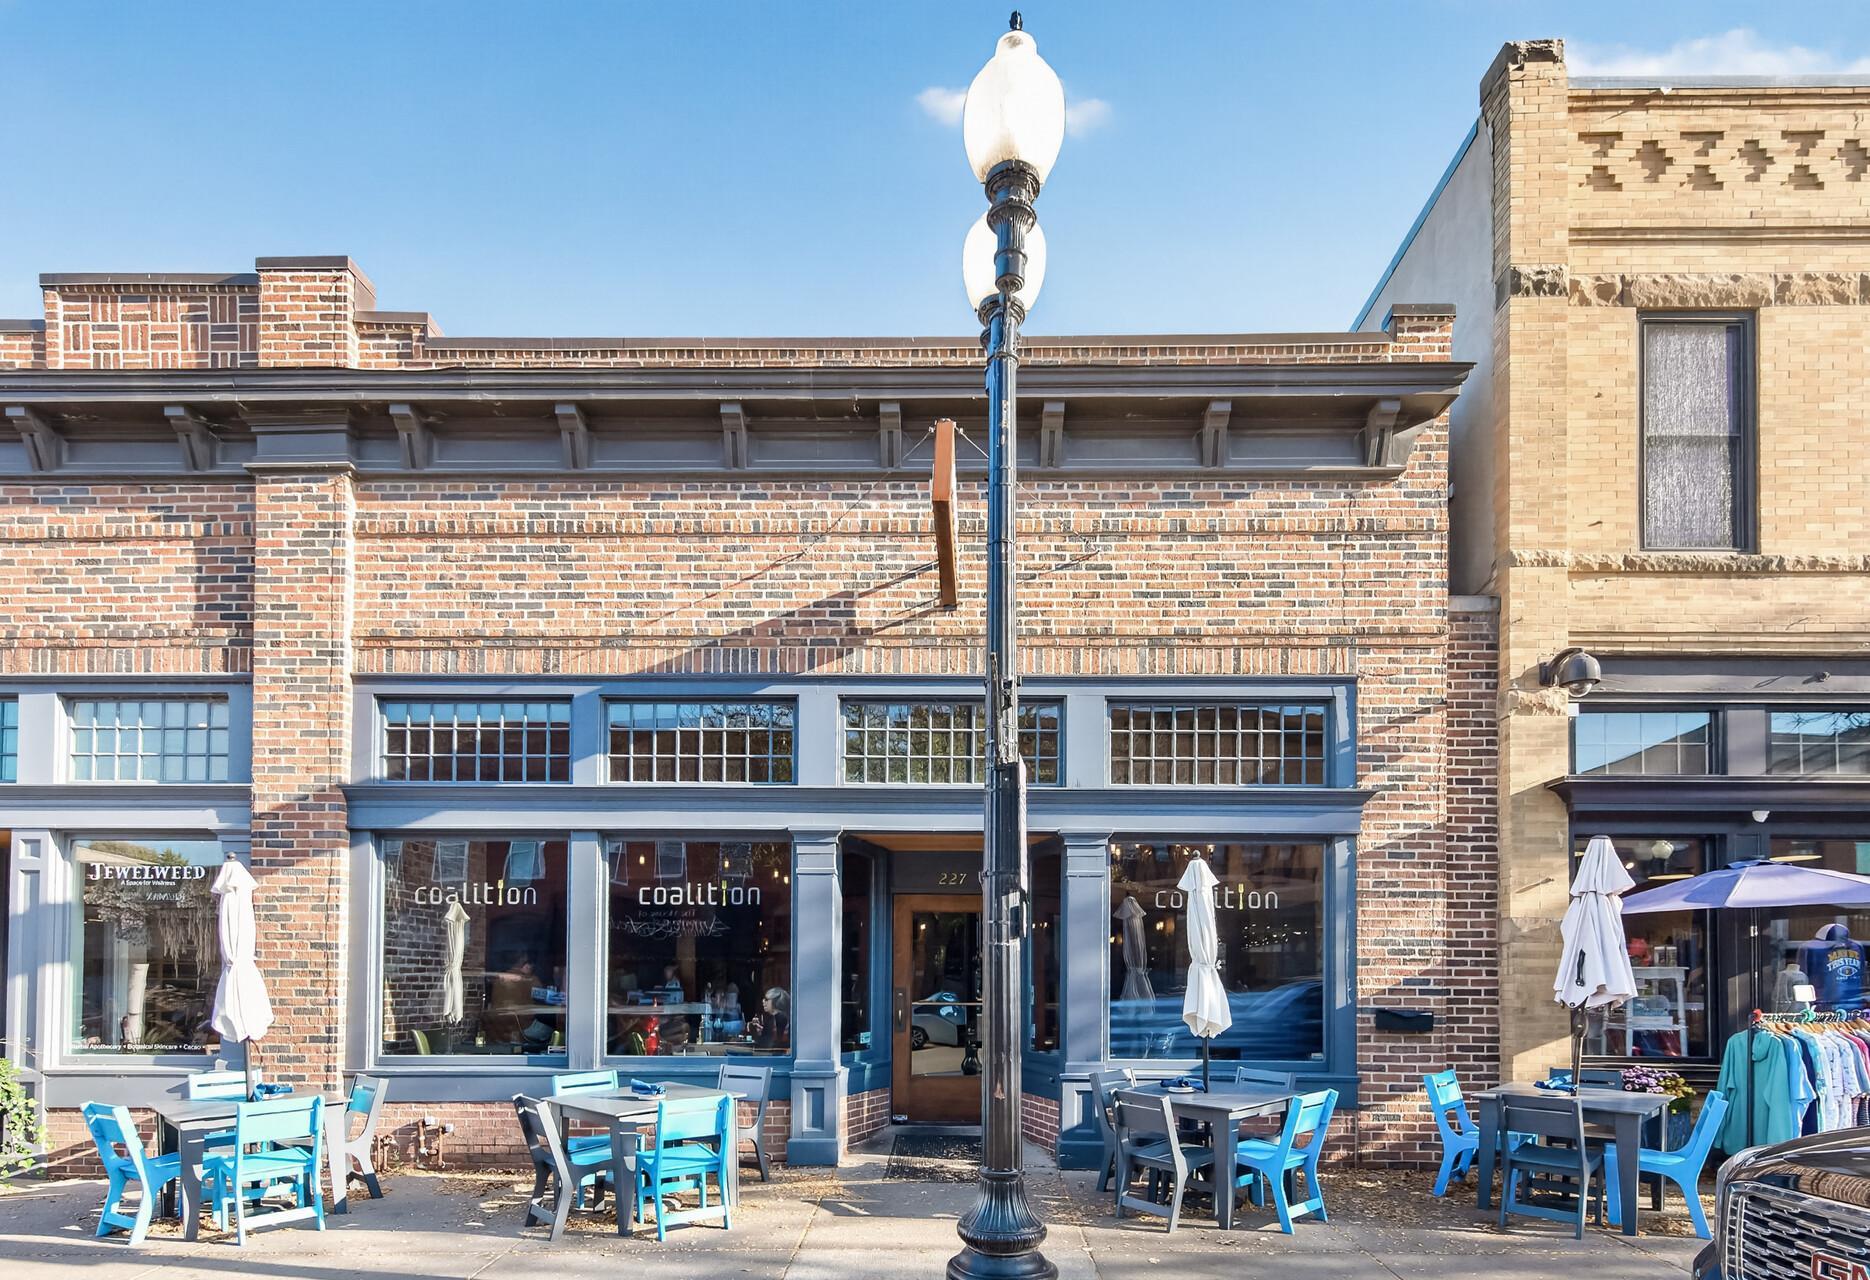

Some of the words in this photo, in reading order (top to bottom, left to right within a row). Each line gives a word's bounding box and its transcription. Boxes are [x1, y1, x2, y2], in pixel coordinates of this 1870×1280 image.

[88, 862, 205, 880] JEWELWEED
[938, 872, 967, 885] 227
[415, 880, 536, 906] coalition
[639, 880, 761, 906] coalition
[1155, 884, 1278, 910] coition
